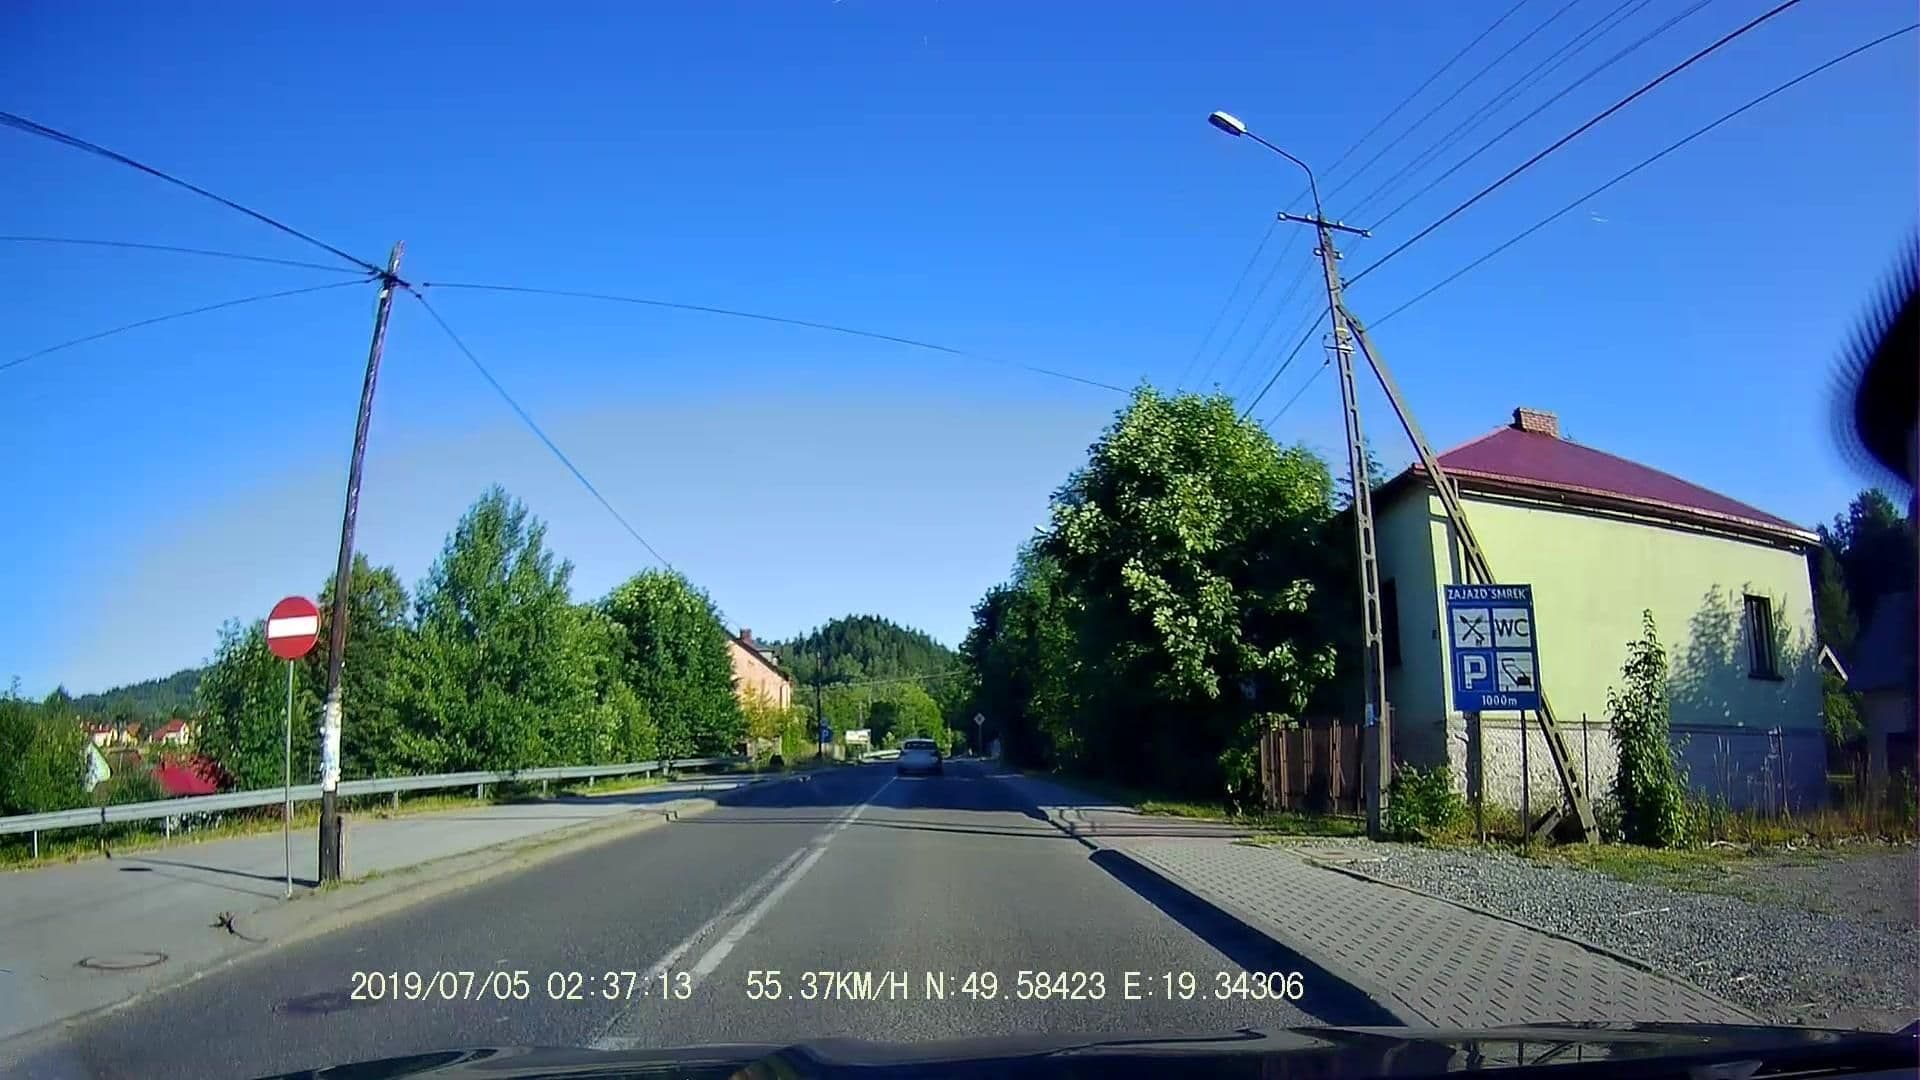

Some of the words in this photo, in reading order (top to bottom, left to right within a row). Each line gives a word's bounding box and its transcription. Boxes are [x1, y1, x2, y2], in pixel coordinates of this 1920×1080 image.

[1447, 588, 1488, 600] ZAJAZD
[1495, 618, 1528, 637] WC
[1463, 655, 1487, 689] P
